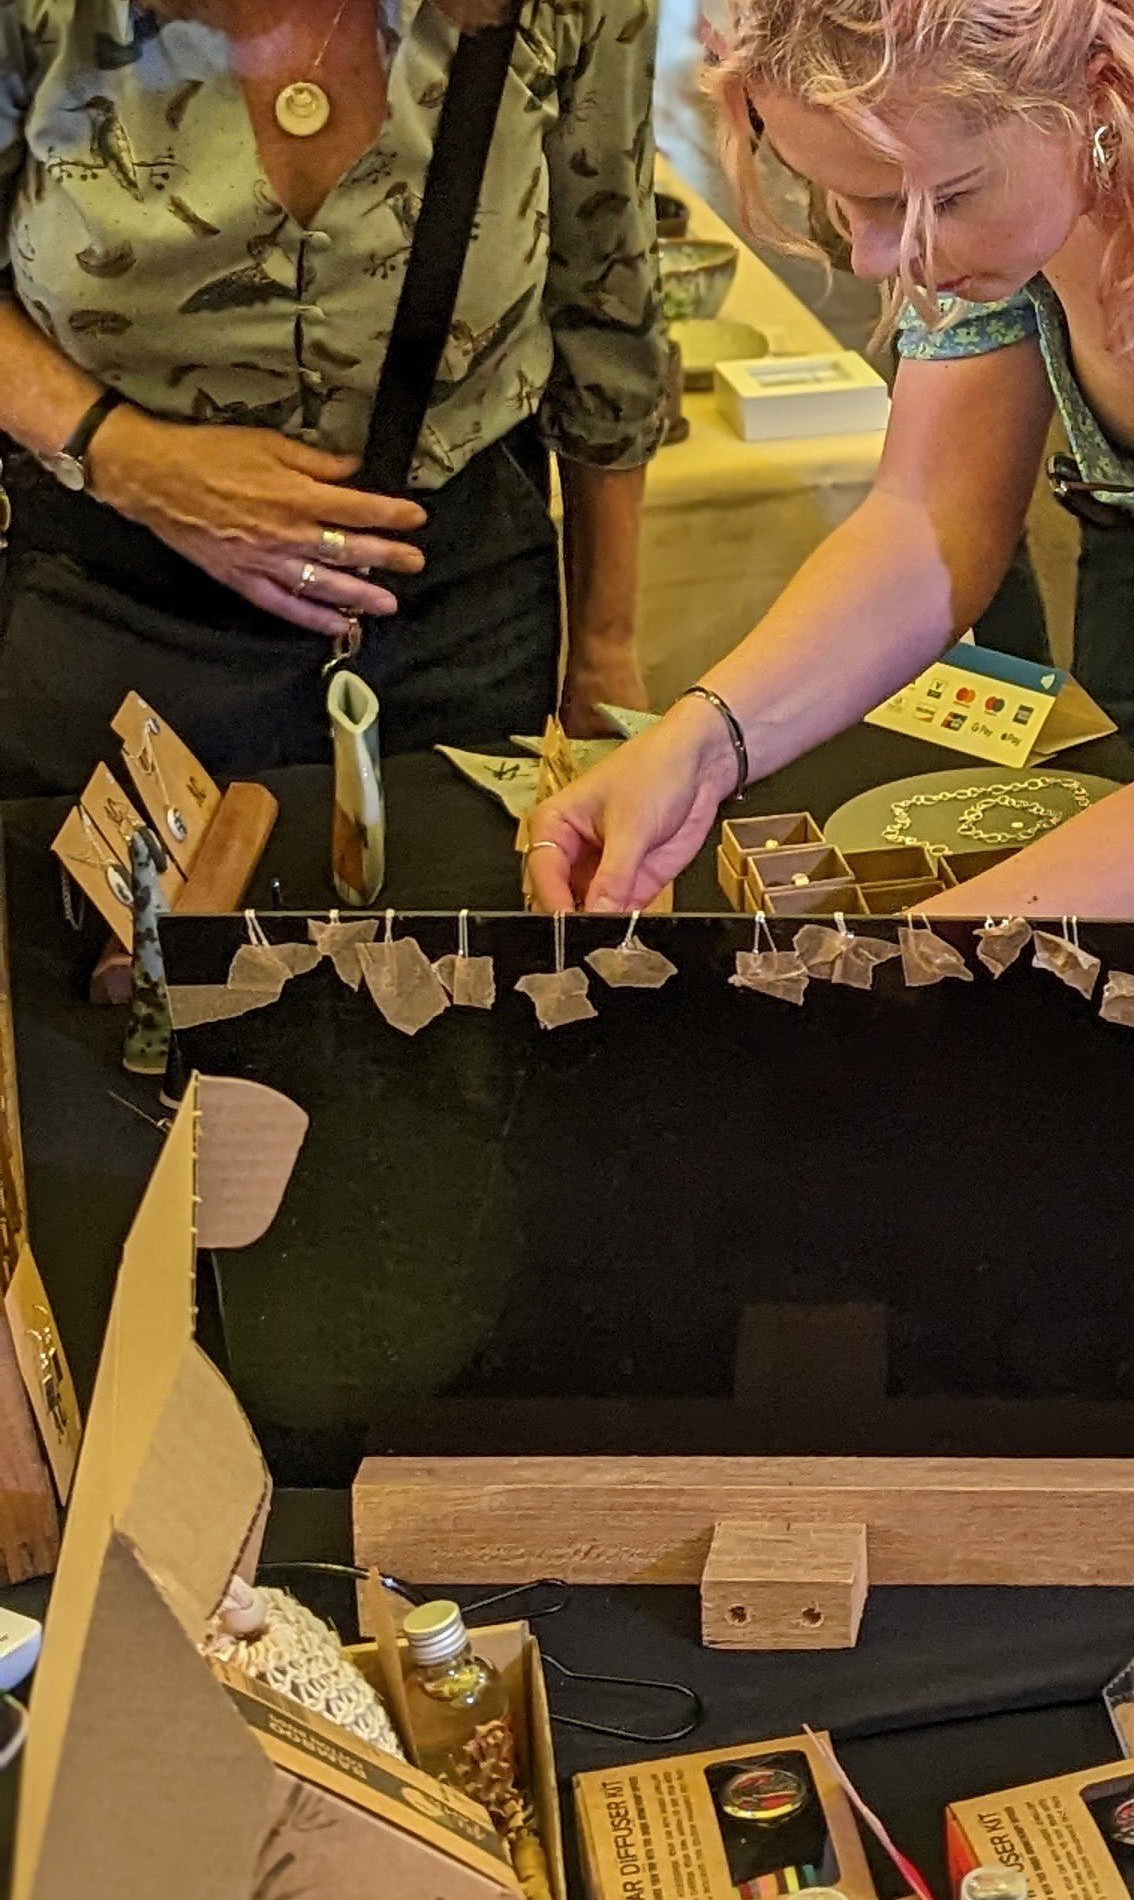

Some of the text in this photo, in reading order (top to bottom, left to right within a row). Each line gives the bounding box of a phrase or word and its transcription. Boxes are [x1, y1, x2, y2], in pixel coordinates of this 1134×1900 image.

[601, 1781, 624, 1799] KIT
[979, 1812, 1006, 1833] KIT
[607, 1800, 641, 1876] DIFFUSER
